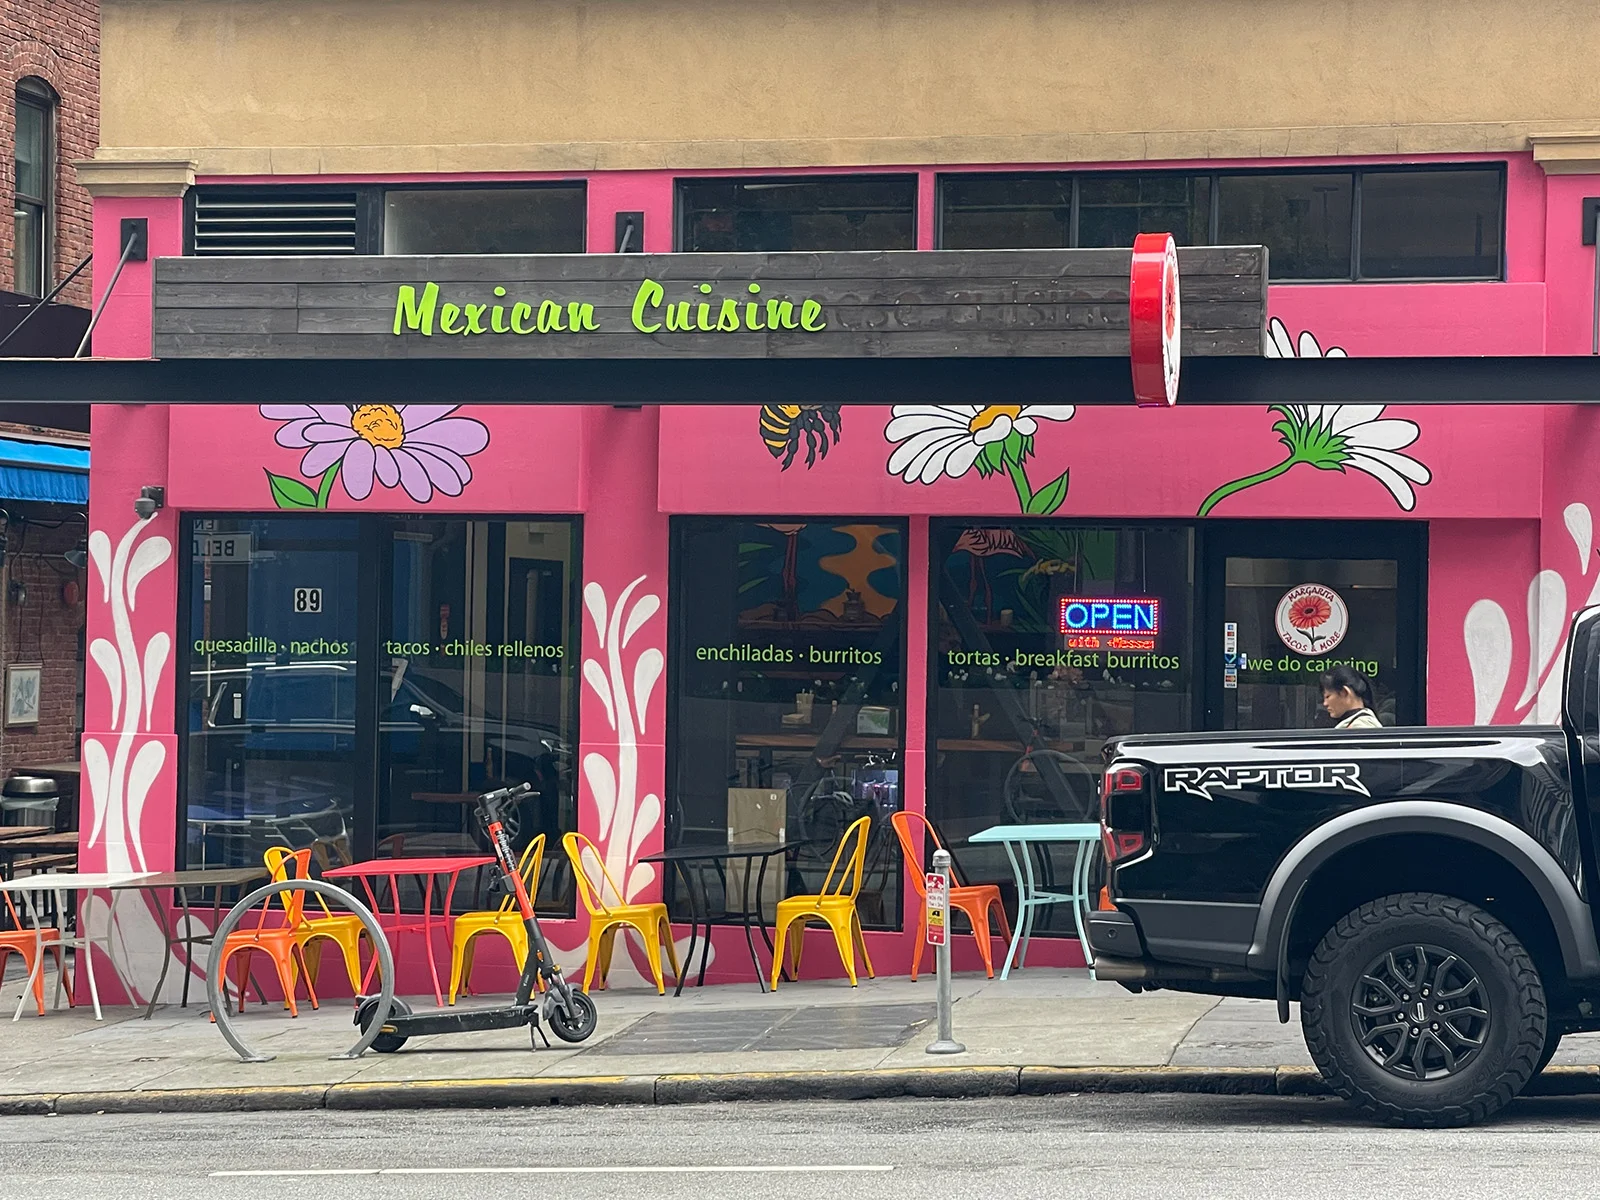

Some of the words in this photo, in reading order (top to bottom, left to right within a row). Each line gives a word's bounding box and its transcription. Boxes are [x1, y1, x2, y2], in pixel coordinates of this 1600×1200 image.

[392, 281, 600, 336] Mexican
[631, 278, 826, 334] Cuisine
[296, 588, 322, 611] 89
[1287, 586, 1335, 603] MARGARITA
[1065, 603, 1154, 630] OPEN
[193, 638, 278, 658] quesadilla
[290, 640, 349, 656] nachos
[386, 641, 430, 656] tacos
[444, 639, 493, 657] chiles
[497, 641, 564, 659] rellenos
[1282, 631, 1308, 652] TACOS
[1319, 631, 1341, 651] MORE
[695, 644, 794, 664] enchiladas
[809, 646, 882, 666] burritos
[948, 650, 1001, 667] tortas
[1015, 649, 1099, 669] breakfast
[1107, 652, 1180, 670] burritos
[1248, 659, 1273, 671] we
[1278, 655, 1301, 672] do
[1164, 763, 1371, 801] RAPTOR
